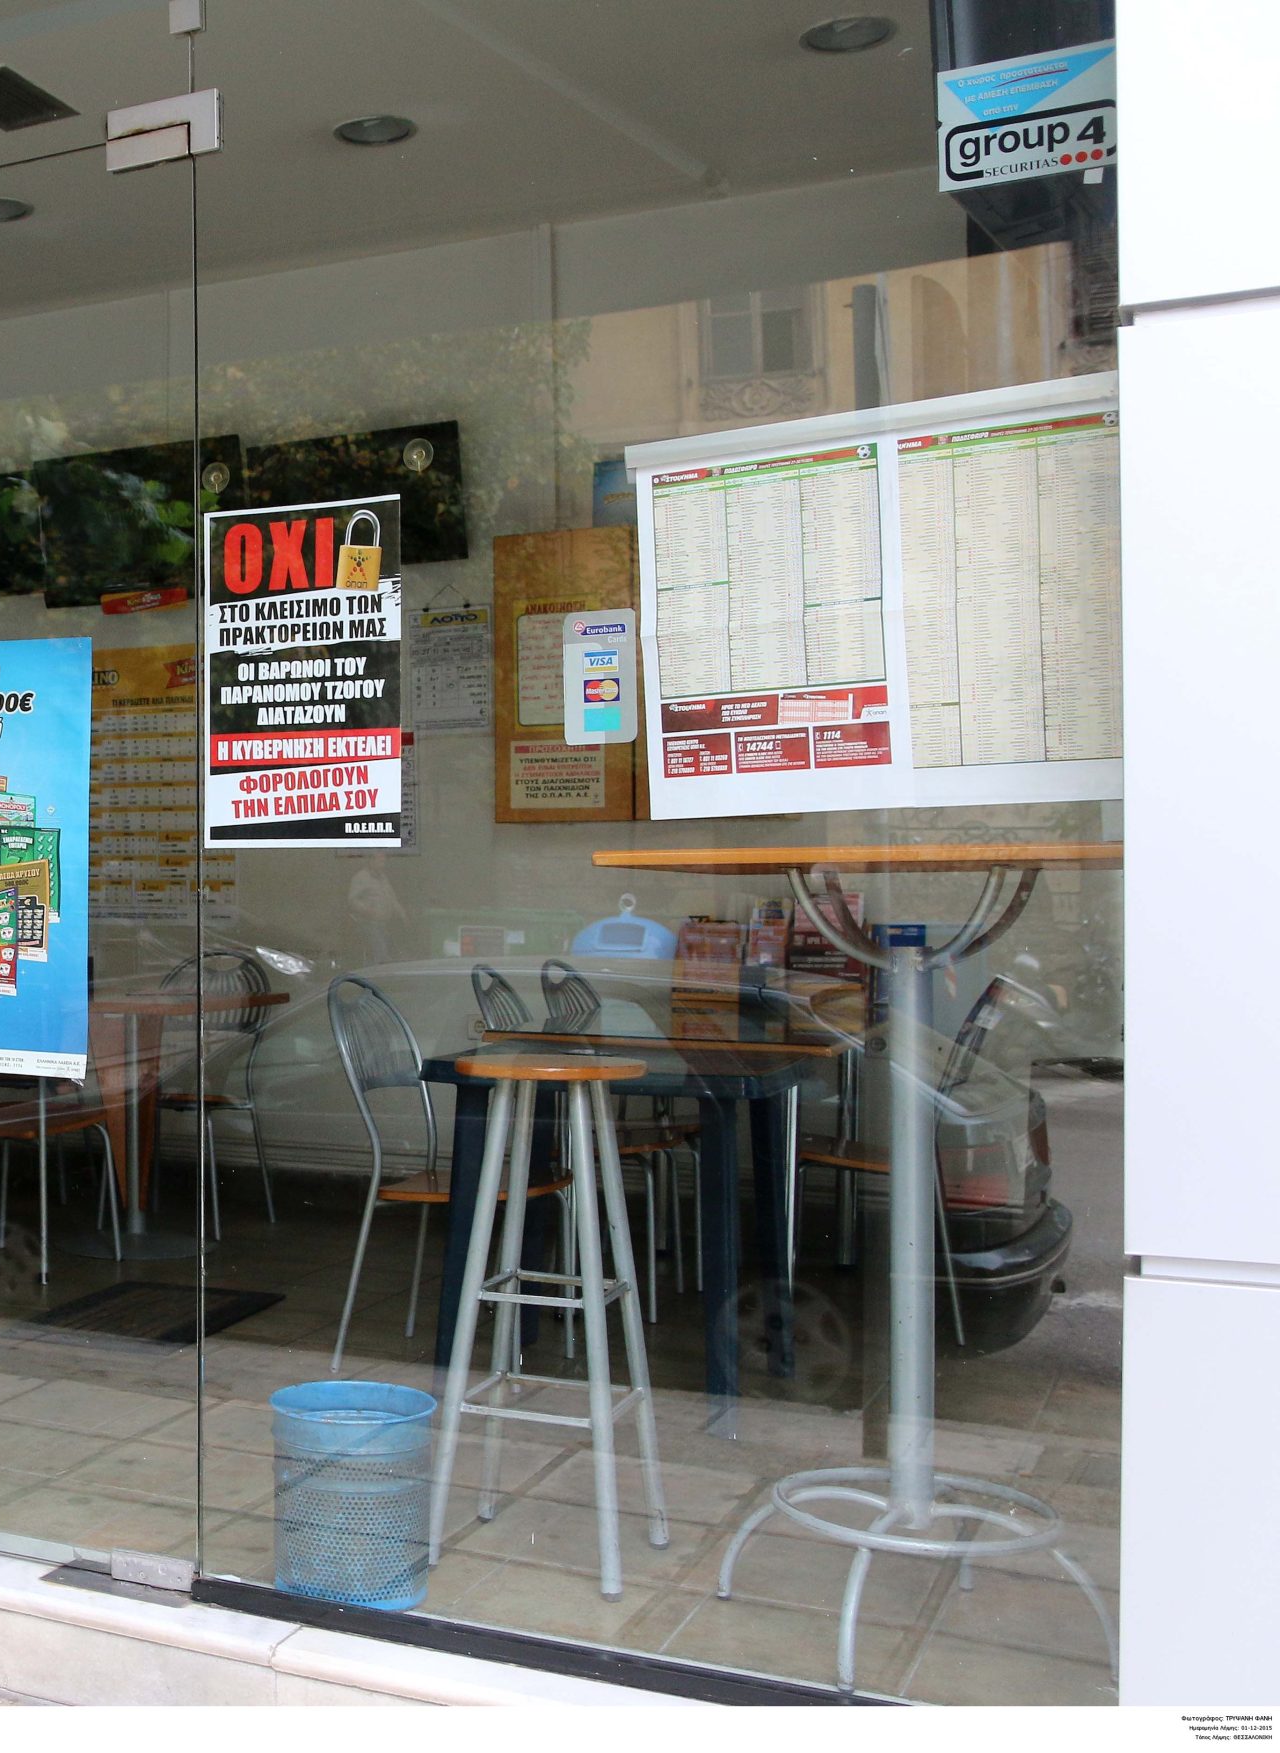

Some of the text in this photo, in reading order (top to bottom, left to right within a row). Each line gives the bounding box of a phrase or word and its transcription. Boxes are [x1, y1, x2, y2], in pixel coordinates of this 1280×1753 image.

[959, 115, 1107, 167] group 4
[983, 156, 1059, 178] SECURITAS
[897, 440, 922, 450] ΙΧΗΜΑ
[223, 516, 335, 595] ΟΧΙ
[218, 593, 383, 623] ΣΤΟ ΚΛΕΙΣΙΜΟ ΤΩΝ
[219, 617, 387, 647] ΠΡΑΚΤΟΡΕΙΩΝ ΜΑΣ
[585, 624, 623, 634] Eurobank
[237, 656, 367, 682] ΟΙ ΒΑΡΩΝΟΙ ΤΟΥ
[589, 657, 613, 667] VISA
[92, 669, 119, 686] INO
[220, 682, 322, 705] ΠΑΡΑΝΟΜΟΥ
[324, 679, 386, 700] ΤΖΟΓΟΥ
[256, 704, 346, 726] ΔΙΑΤΑΖΟΥΝ
[746, 741, 774, 752] 14744
[823, 730, 841, 740] 1114
[217, 735, 392, 761] Η ΚΥΒΕΡΝΗΣΗ ΕΚΤΕΛΕΙ
[239, 765, 369, 794] ΦΟΡΟΛΟΓΟΥΝ
[541, 777, 600, 785] ΔΙΑΓΩΝΙΣΜΟΥΣ
[231, 788, 378, 819] ΤΗΝ ΕΛΠΙΔΑ ΣΟΥ
